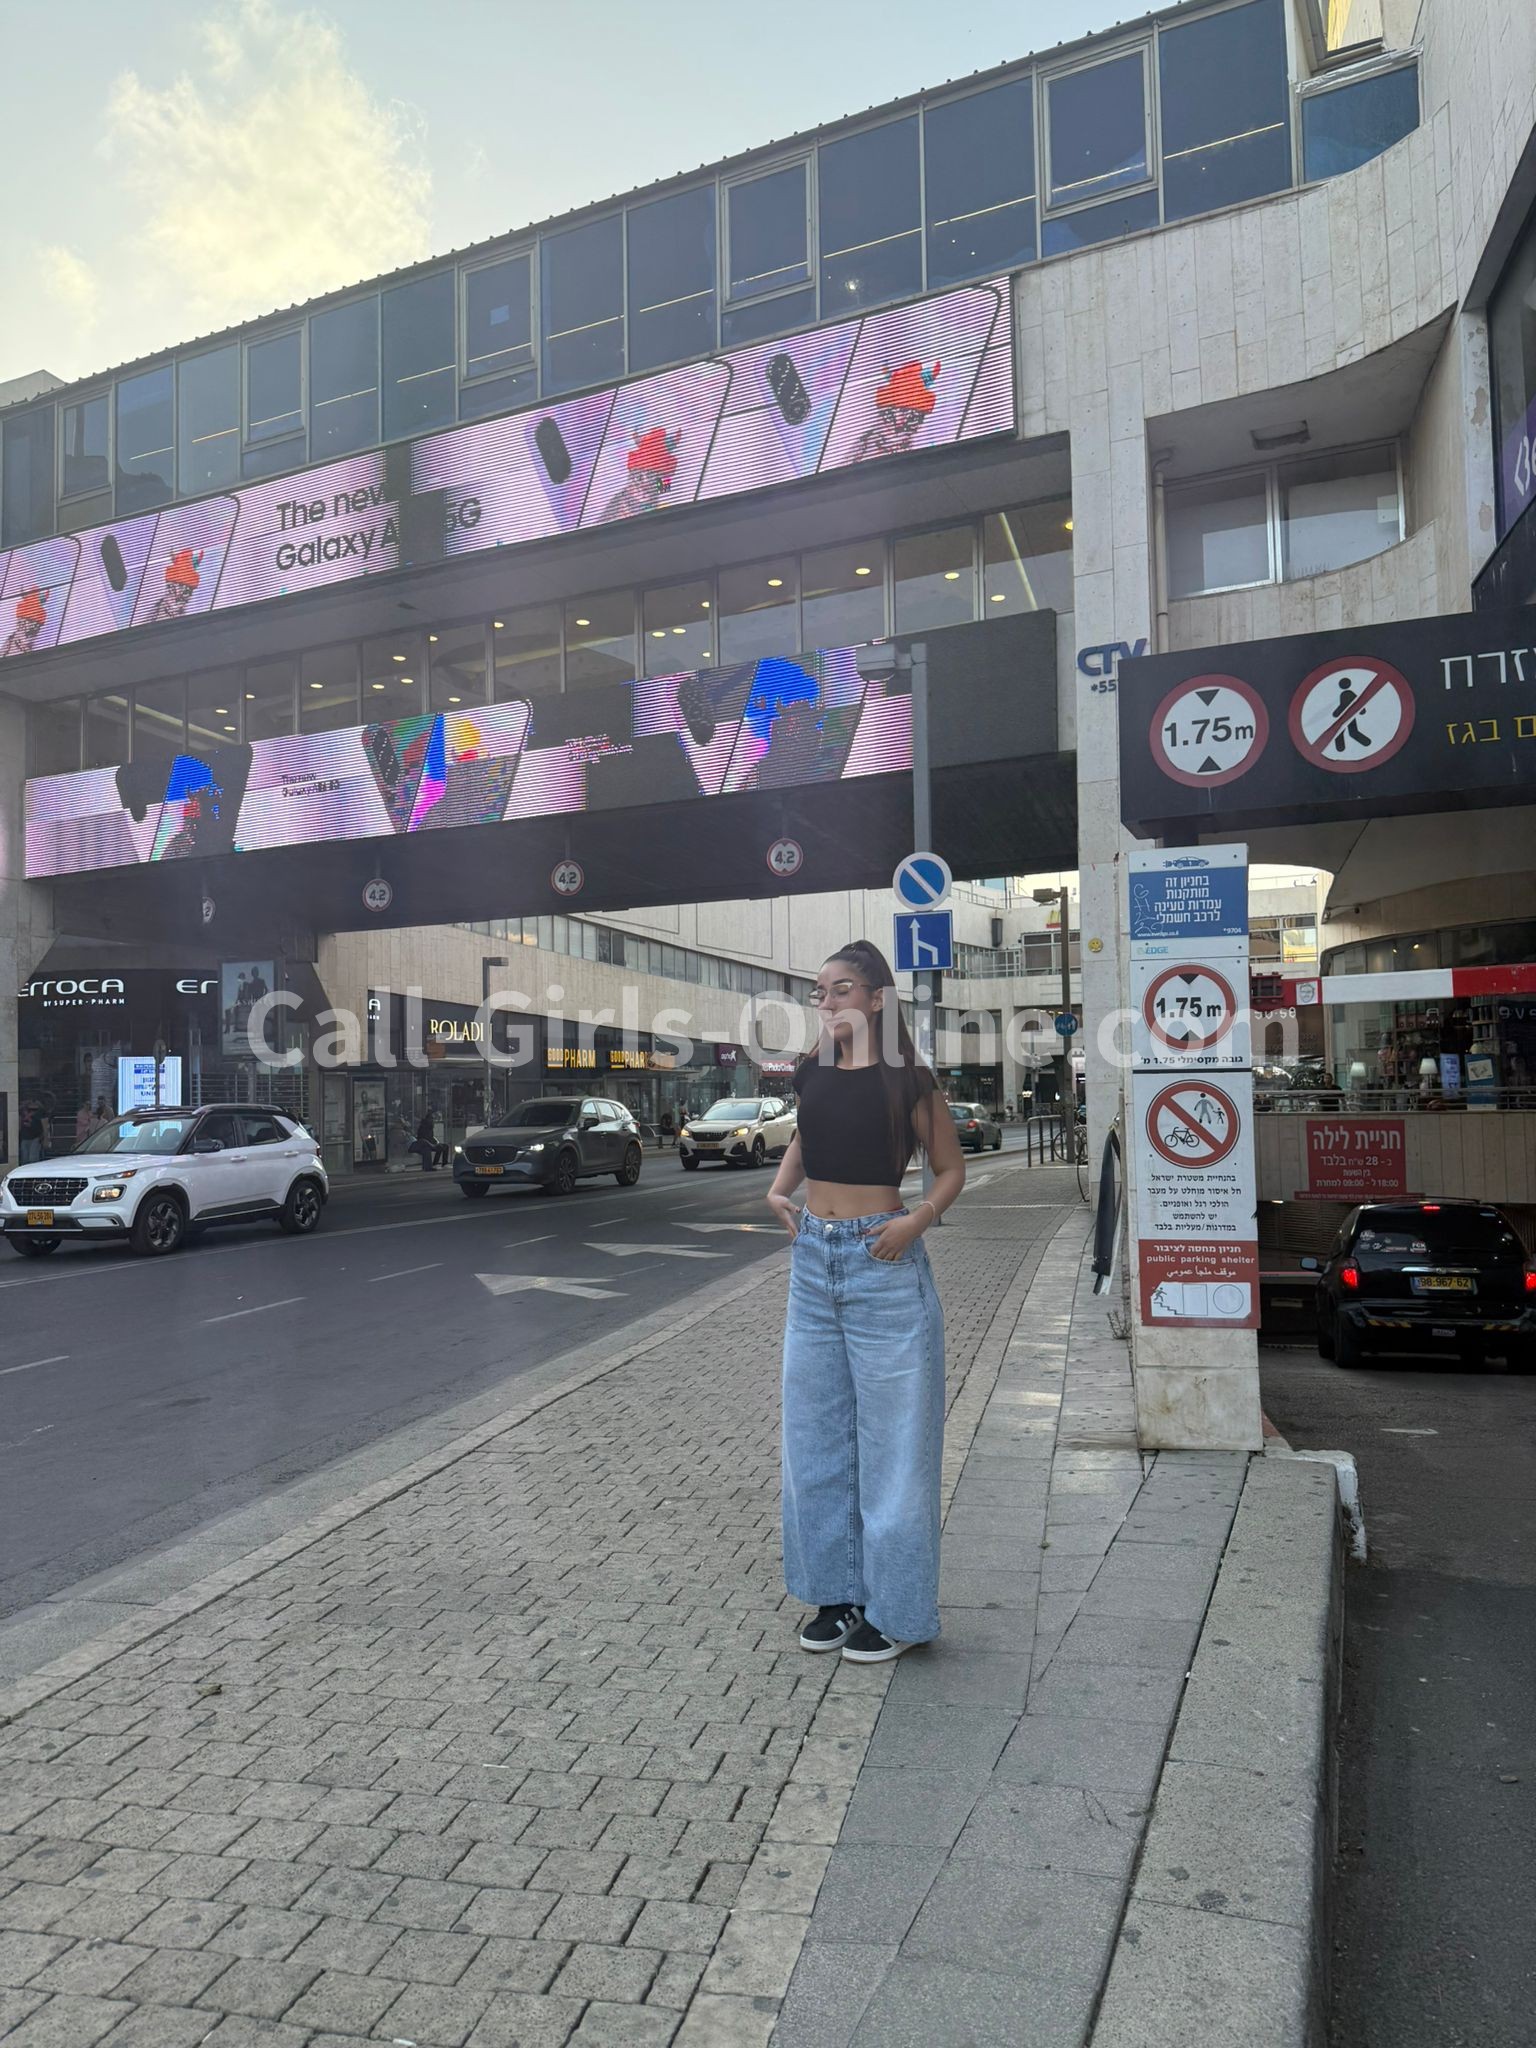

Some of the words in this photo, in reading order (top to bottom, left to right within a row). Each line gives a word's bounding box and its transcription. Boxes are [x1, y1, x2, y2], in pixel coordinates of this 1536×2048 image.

[276, 500, 326, 531] The
[276, 528, 375, 571] Galaxy
[1440, 647, 1536, 690] זרח
[1446, 719, 1501, 744] בגז
[1165, 877, 1177, 888] זה
[1181, 875, 1210, 889] בחניון
[1166, 887, 1210, 901] מותקנות
[1154, 901, 1185, 913] טעינה
[1188, 899, 1222, 911] עמדות
[1156, 912, 1191, 924] חשמלי
[1193, 909, 1221, 922] לרכב
[564, 1048, 596, 1068] PHARM
[1222, 1055, 1244, 1063] גובה
[1313, 1125, 1350, 1150] לילה
[1355, 1129, 1401, 1150] חניית
[1320, 1154, 1347, 1166] בלבד
[1365, 1156, 1379, 1166] 28
[1168, 1187, 1178, 1195] על
[1181, 1187, 1205, 1195] מוחלט
[1231, 1187, 1242, 1195] חל
[1195, 1200, 1207, 1208] רגל
[1209, 1200, 1229, 1208] הולכי
[1172, 1212, 1206, 1220] להשתמש
[1155, 1222, 1173, 1231] בלבד
[1153, 1244, 1186, 1252] לציבור
[1187, 1245, 1217, 1253] מחסה
[1218, 1245, 1241, 1254] חניון
[1146, 1255, 1176, 1263] public
[1180, 1255, 1217, 1265] parking
[1221, 1256, 1255, 1264] shelter
[1213, 1267, 1237, 1278] موقف
